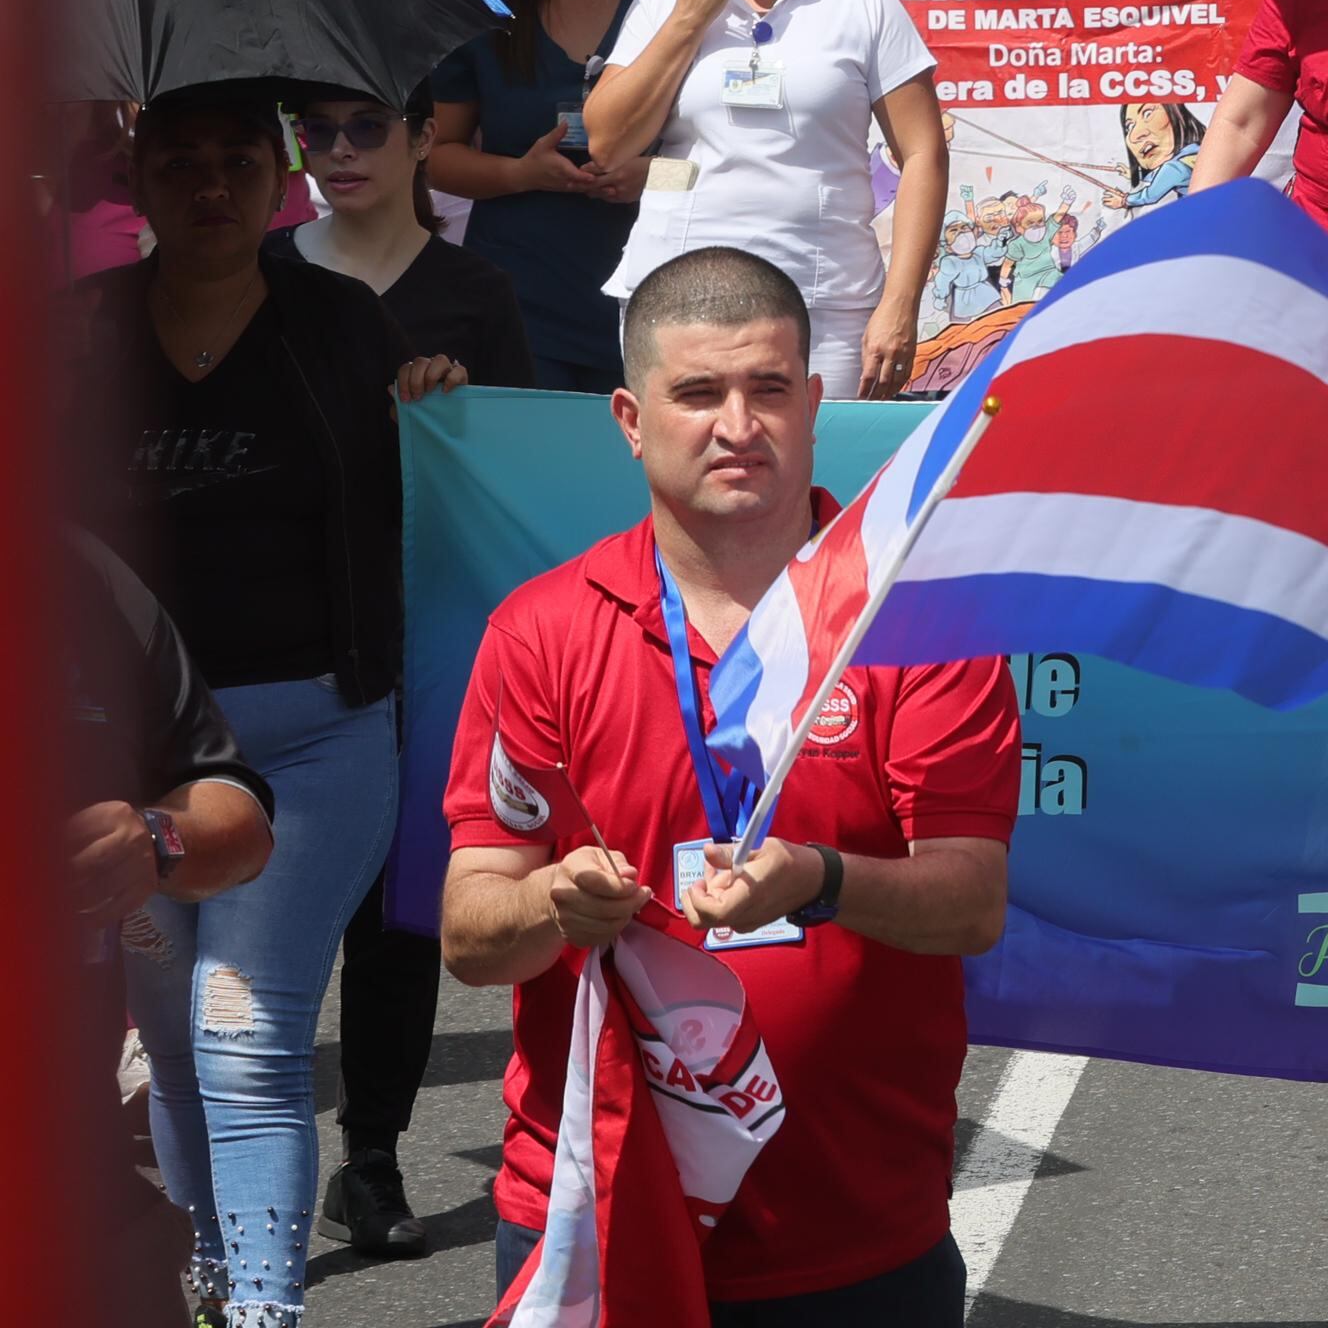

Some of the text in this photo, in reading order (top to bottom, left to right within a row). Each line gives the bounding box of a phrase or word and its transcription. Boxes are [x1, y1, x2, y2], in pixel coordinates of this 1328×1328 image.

[928, 3, 1226, 30] DE MARTA ESQUIVEL
[989, 42, 1164, 67] Doña Marta:
[1004, 73, 1048, 101] de
[1059, 72, 1090, 99] la
[1100, 68, 1206, 101] CCSS,
[128, 428, 257, 473] NIKE
